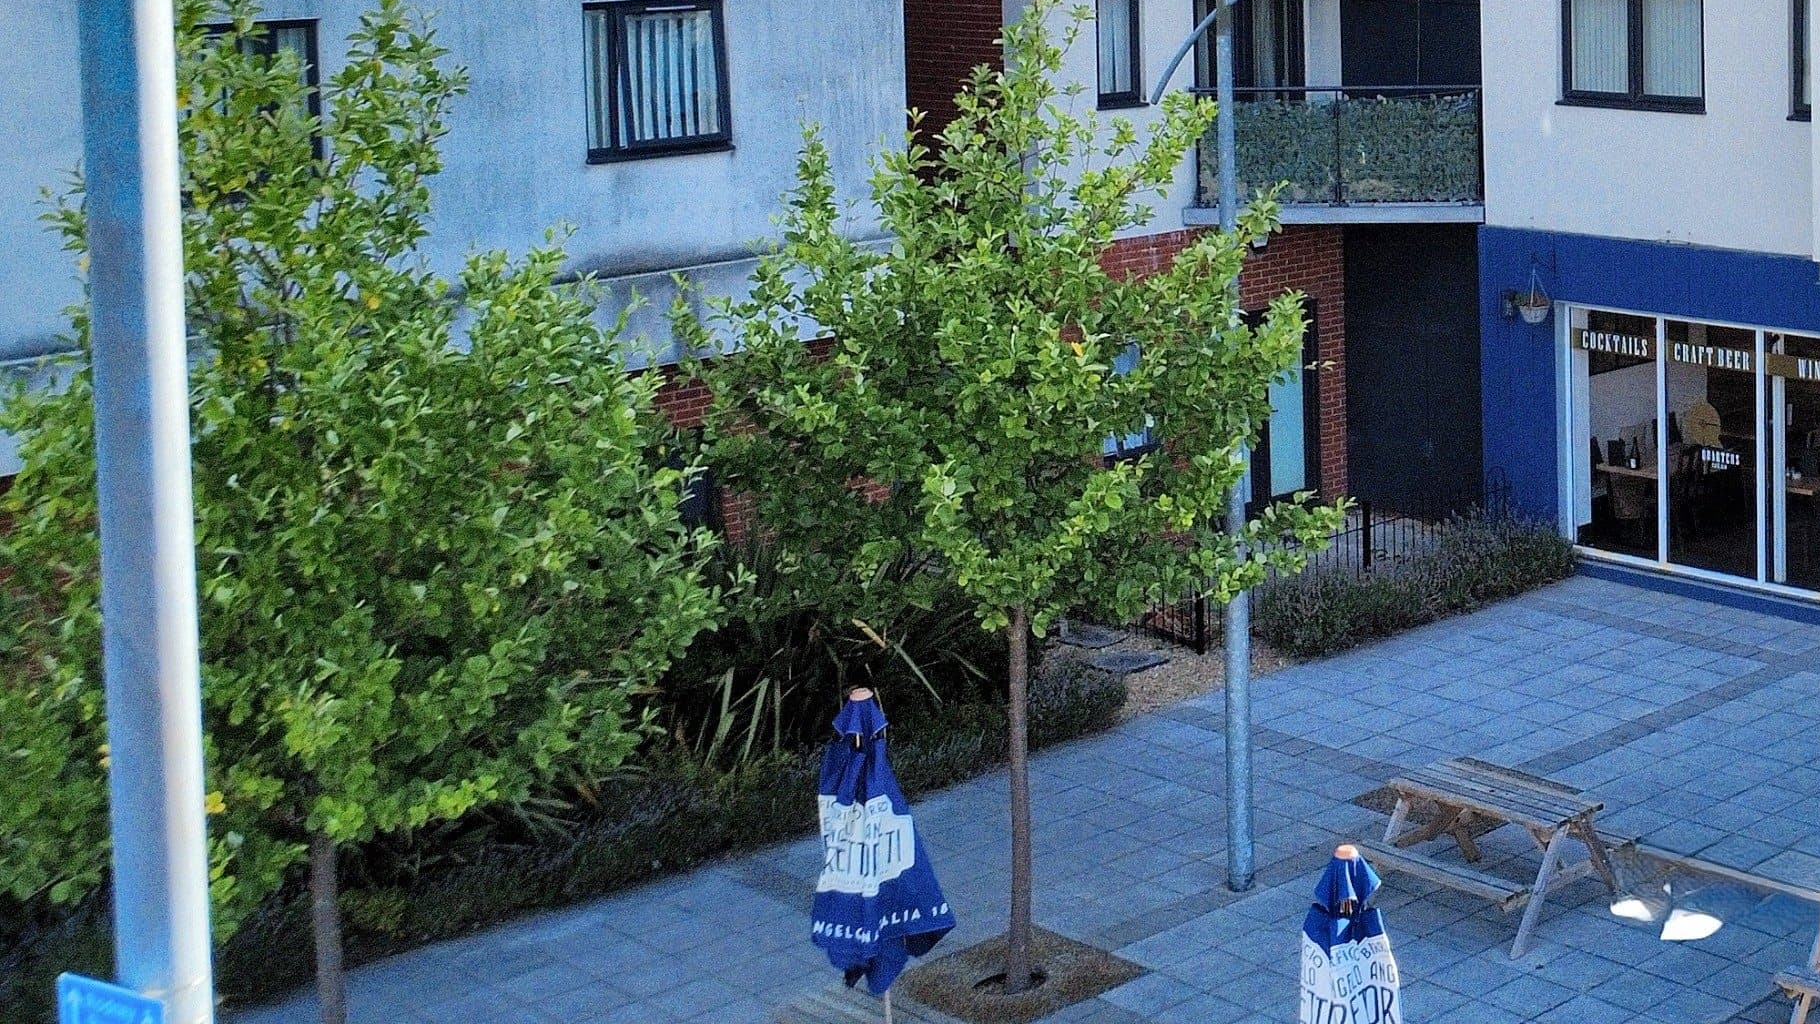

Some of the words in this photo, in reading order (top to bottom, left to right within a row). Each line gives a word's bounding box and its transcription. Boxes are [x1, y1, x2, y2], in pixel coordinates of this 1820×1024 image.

[1581, 329, 1649, 358] COCKTAILS
[1674, 341, 1713, 367] CRAFT
[1717, 346, 1750, 371] BEER
